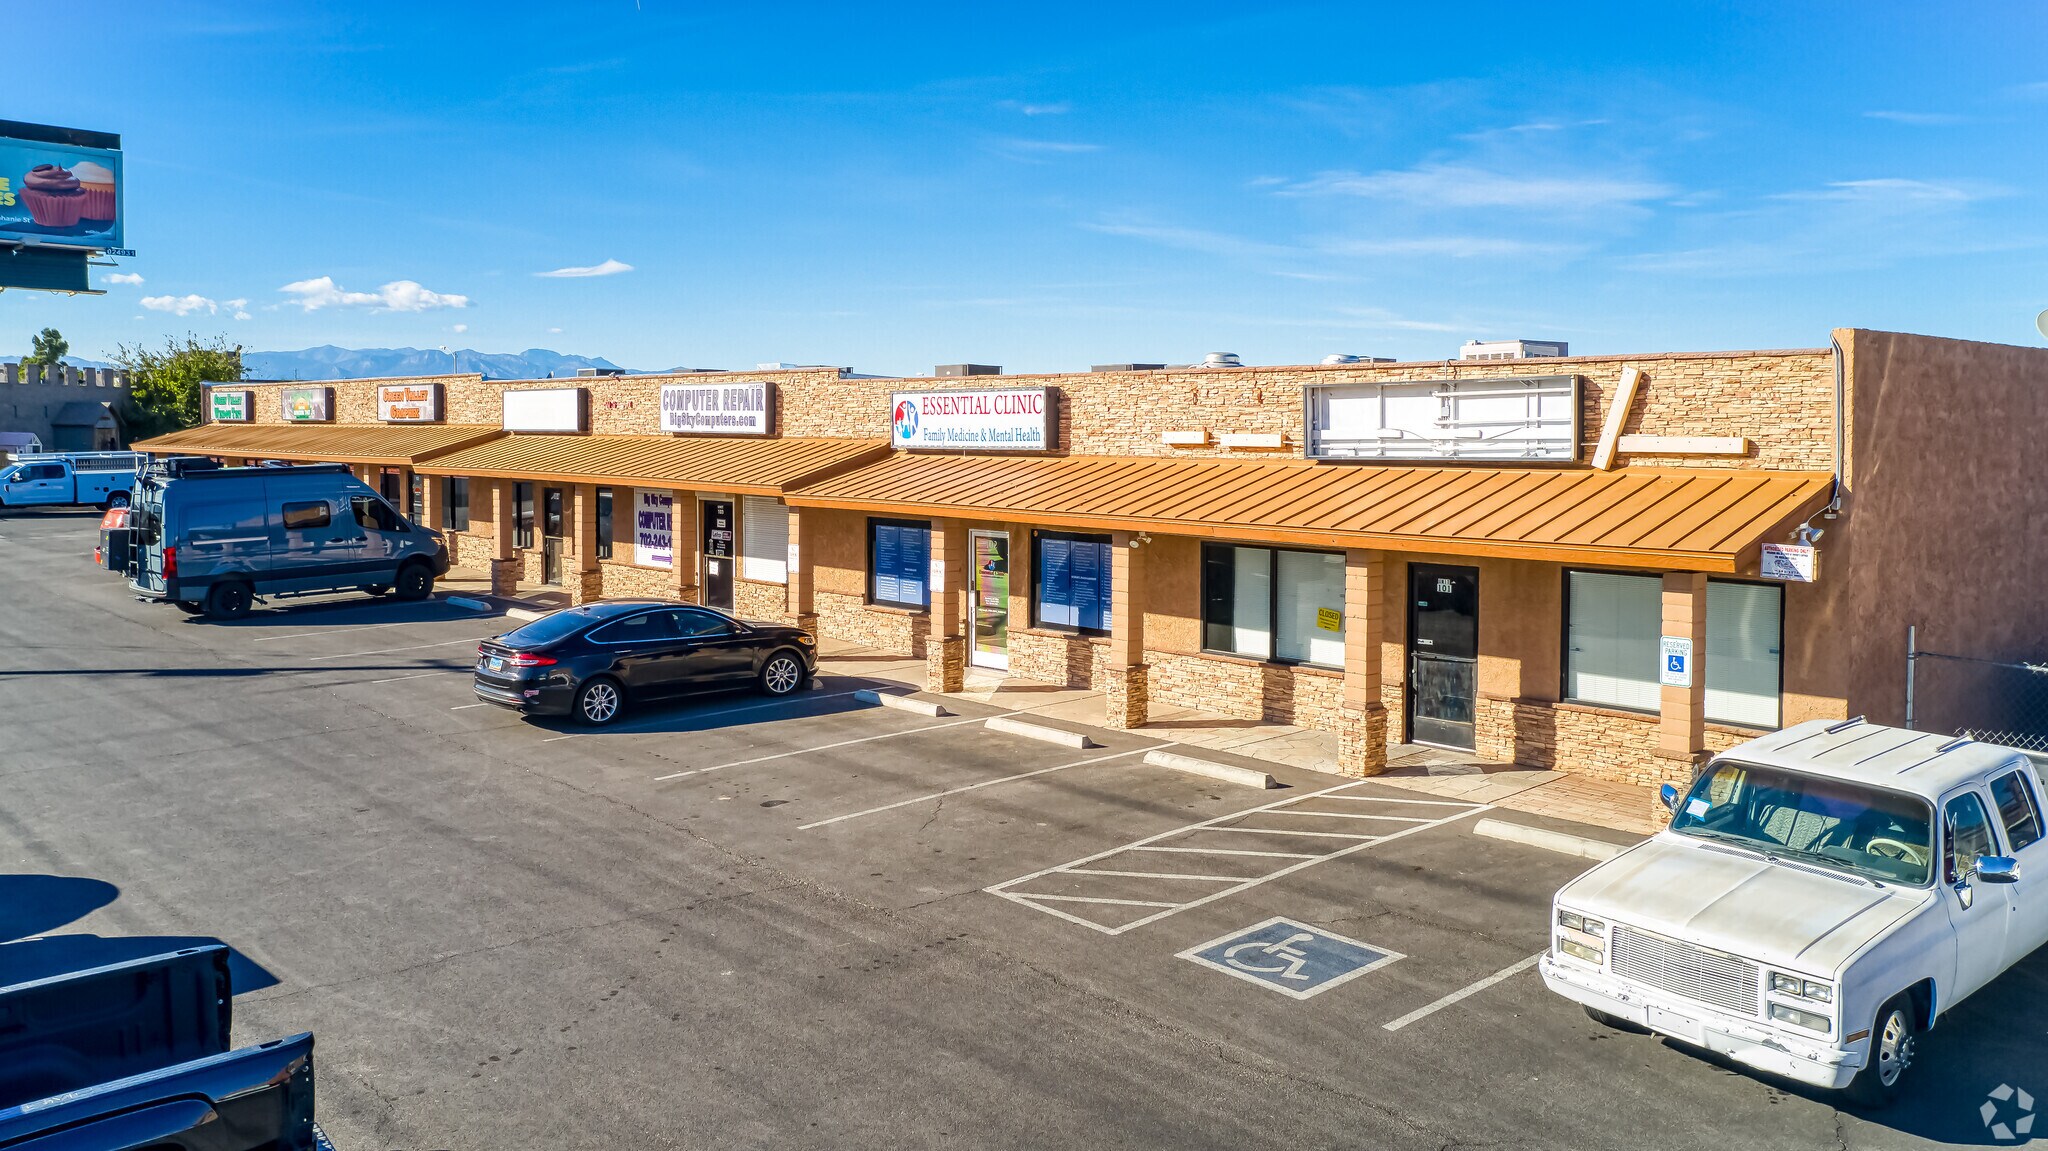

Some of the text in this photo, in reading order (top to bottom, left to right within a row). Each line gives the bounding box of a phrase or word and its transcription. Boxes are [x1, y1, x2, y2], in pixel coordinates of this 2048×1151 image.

[383, 387, 428, 402] GREEN VALLEY
[663, 388, 764, 412] COMPUTER REPAIR
[922, 394, 1042, 415] ESSENTIAL CLINIC
[669, 412, 757, 429] BigSkyComputers.com
[923, 427, 1041, 446] Family Medicine & Mental Health
[638, 511, 666, 530] COMPUTER
[987, 541, 997, 549] 102
[1437, 584, 1452, 593] 101
[1319, 609, 1338, 620] CLOSED
[1663, 641, 1689, 649] RESERVED
[1665, 648, 1687, 656] PARKING
